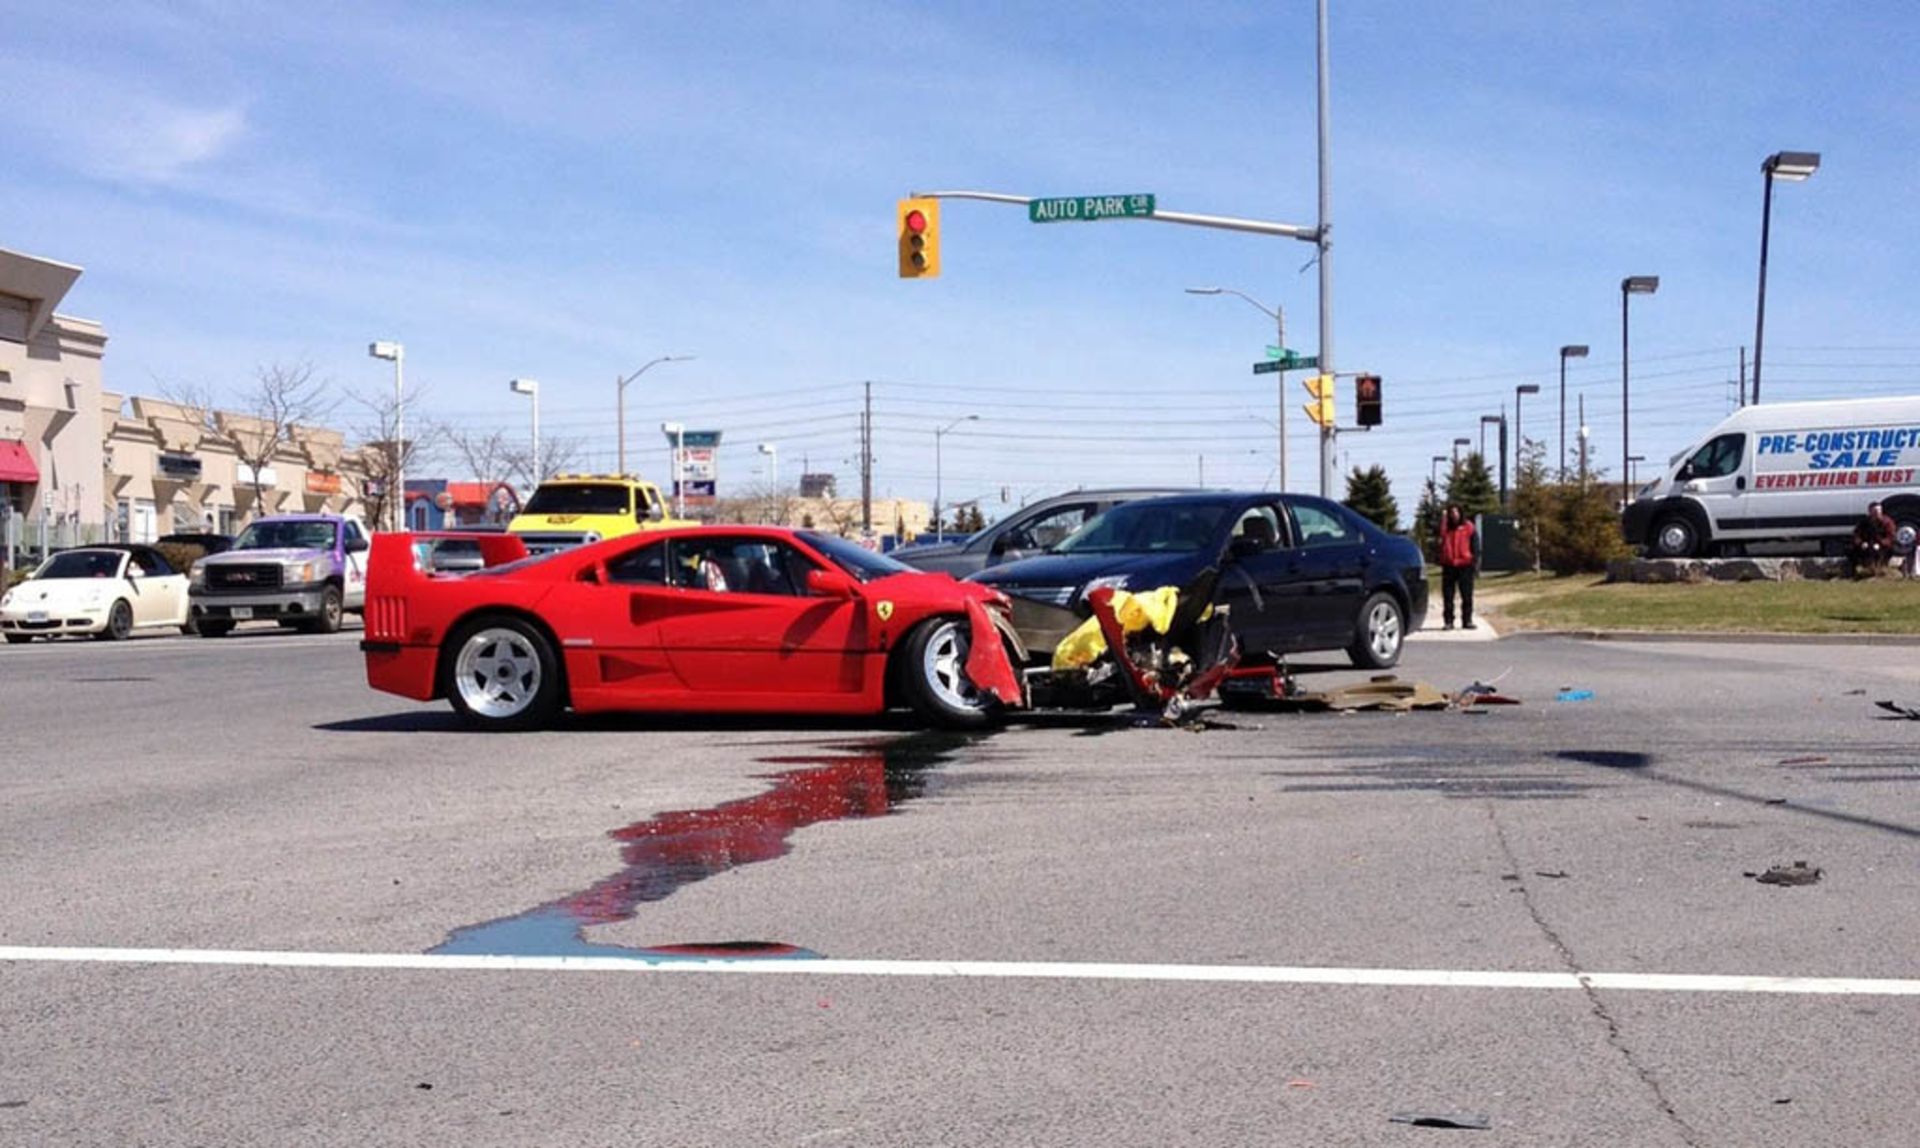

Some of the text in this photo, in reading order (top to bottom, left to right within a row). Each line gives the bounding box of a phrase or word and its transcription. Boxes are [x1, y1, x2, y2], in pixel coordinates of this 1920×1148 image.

[1036, 199, 1078, 218] AUTO
[1084, 197, 1125, 216] PARK
[1758, 428, 1920, 455] PRE-CONSTRUCT
[1808, 450, 1901, 469] SALE
[1755, 469, 1915, 489] EVERYTHING MUST
